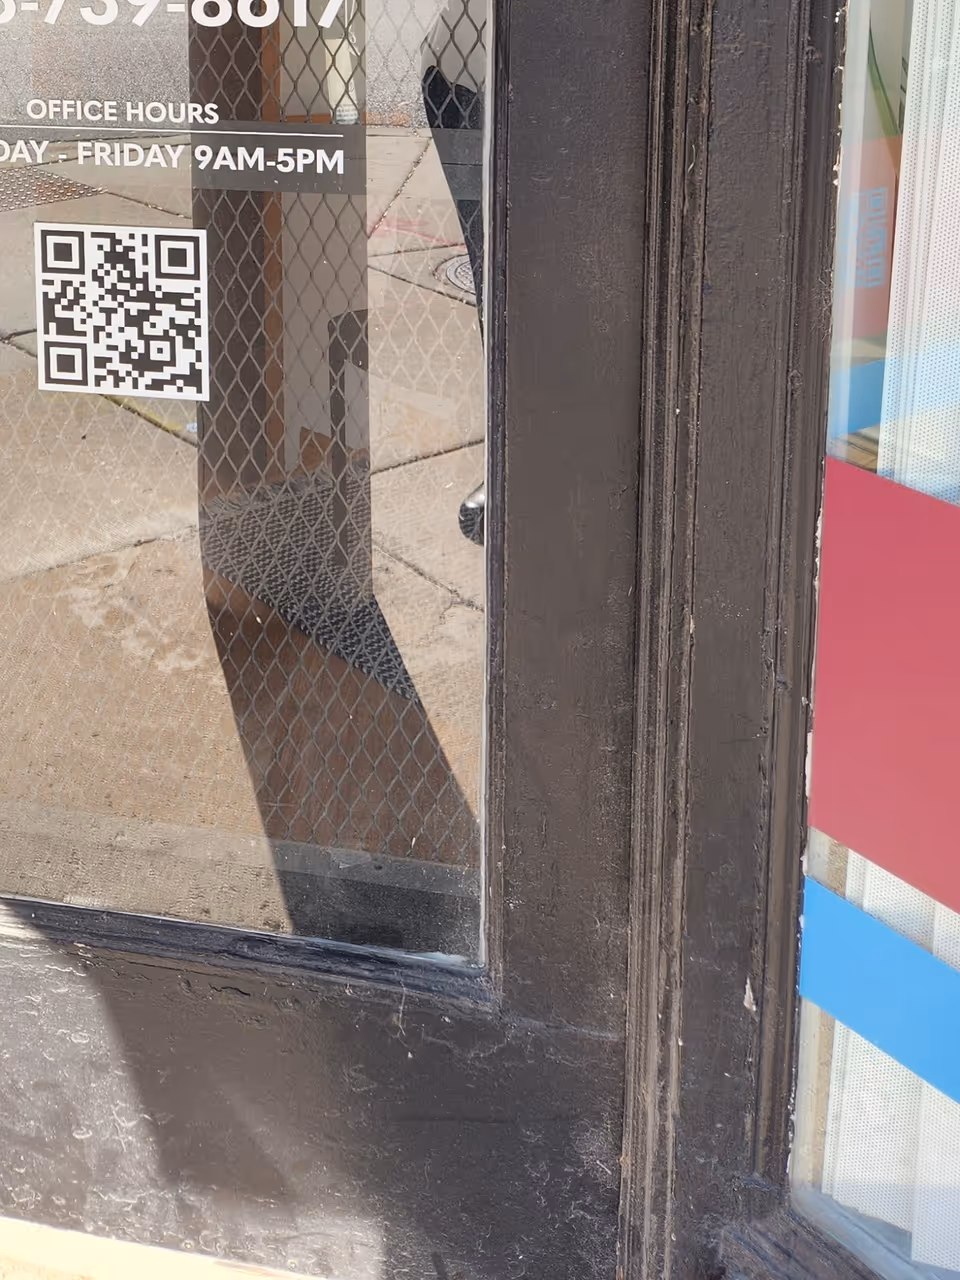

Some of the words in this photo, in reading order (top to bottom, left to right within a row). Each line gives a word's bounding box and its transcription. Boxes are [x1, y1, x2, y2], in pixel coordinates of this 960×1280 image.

[26, 99, 117, 122] OFFICE
[126, 101, 219, 125] HOURS
[77, 142, 185, 168] FRIDAY
[194, 144, 344, 175] 9AM-5PM
